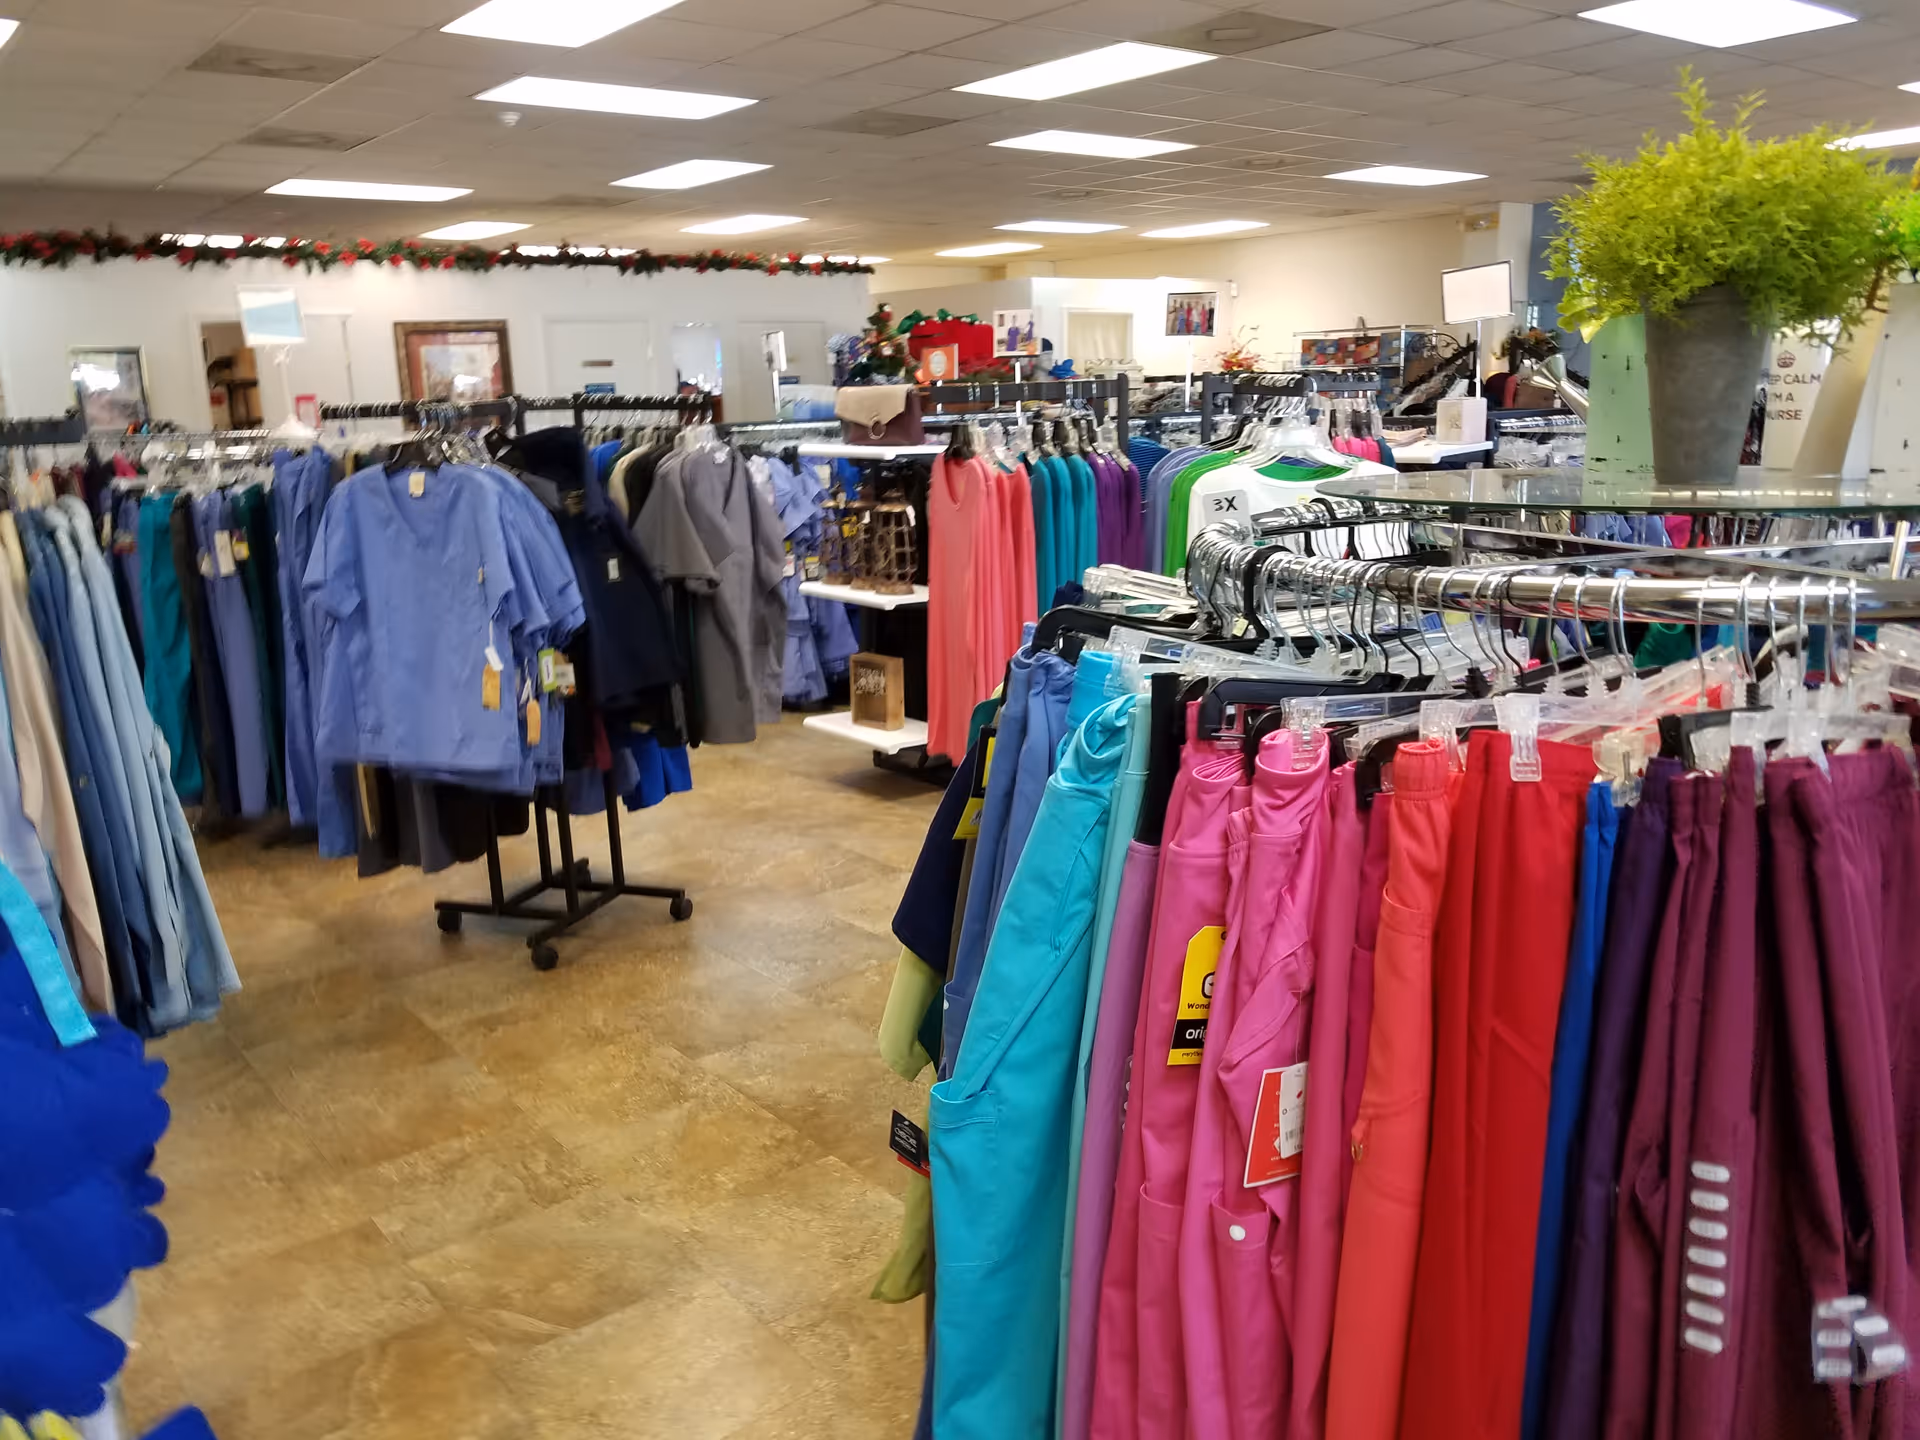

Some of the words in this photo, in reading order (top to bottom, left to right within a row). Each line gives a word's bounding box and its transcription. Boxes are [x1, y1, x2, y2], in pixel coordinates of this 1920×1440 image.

[1784, 374, 1821, 385] CALM
[1785, 392, 1794, 402] A
[1212, 495, 1238, 512] 3X
